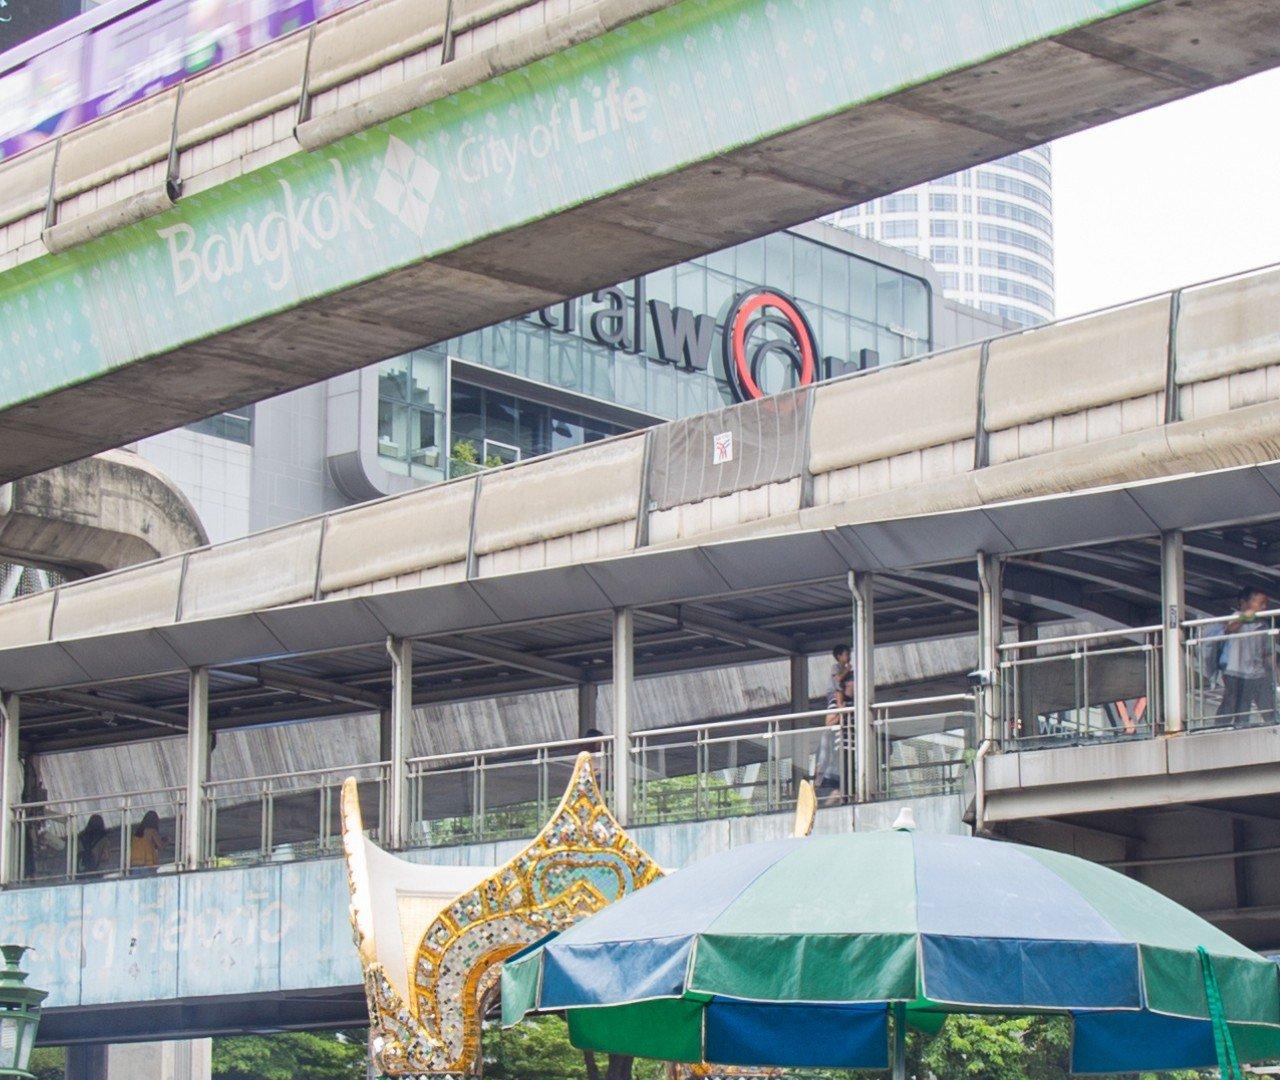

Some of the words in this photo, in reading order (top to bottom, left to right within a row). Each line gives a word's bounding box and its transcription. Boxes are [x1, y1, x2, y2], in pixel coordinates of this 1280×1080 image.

[156, 158, 375, 296] Bangkok
[456, 128, 523, 190] City
[528, 106, 565, 159] of
[569, 74, 649, 145] Life
